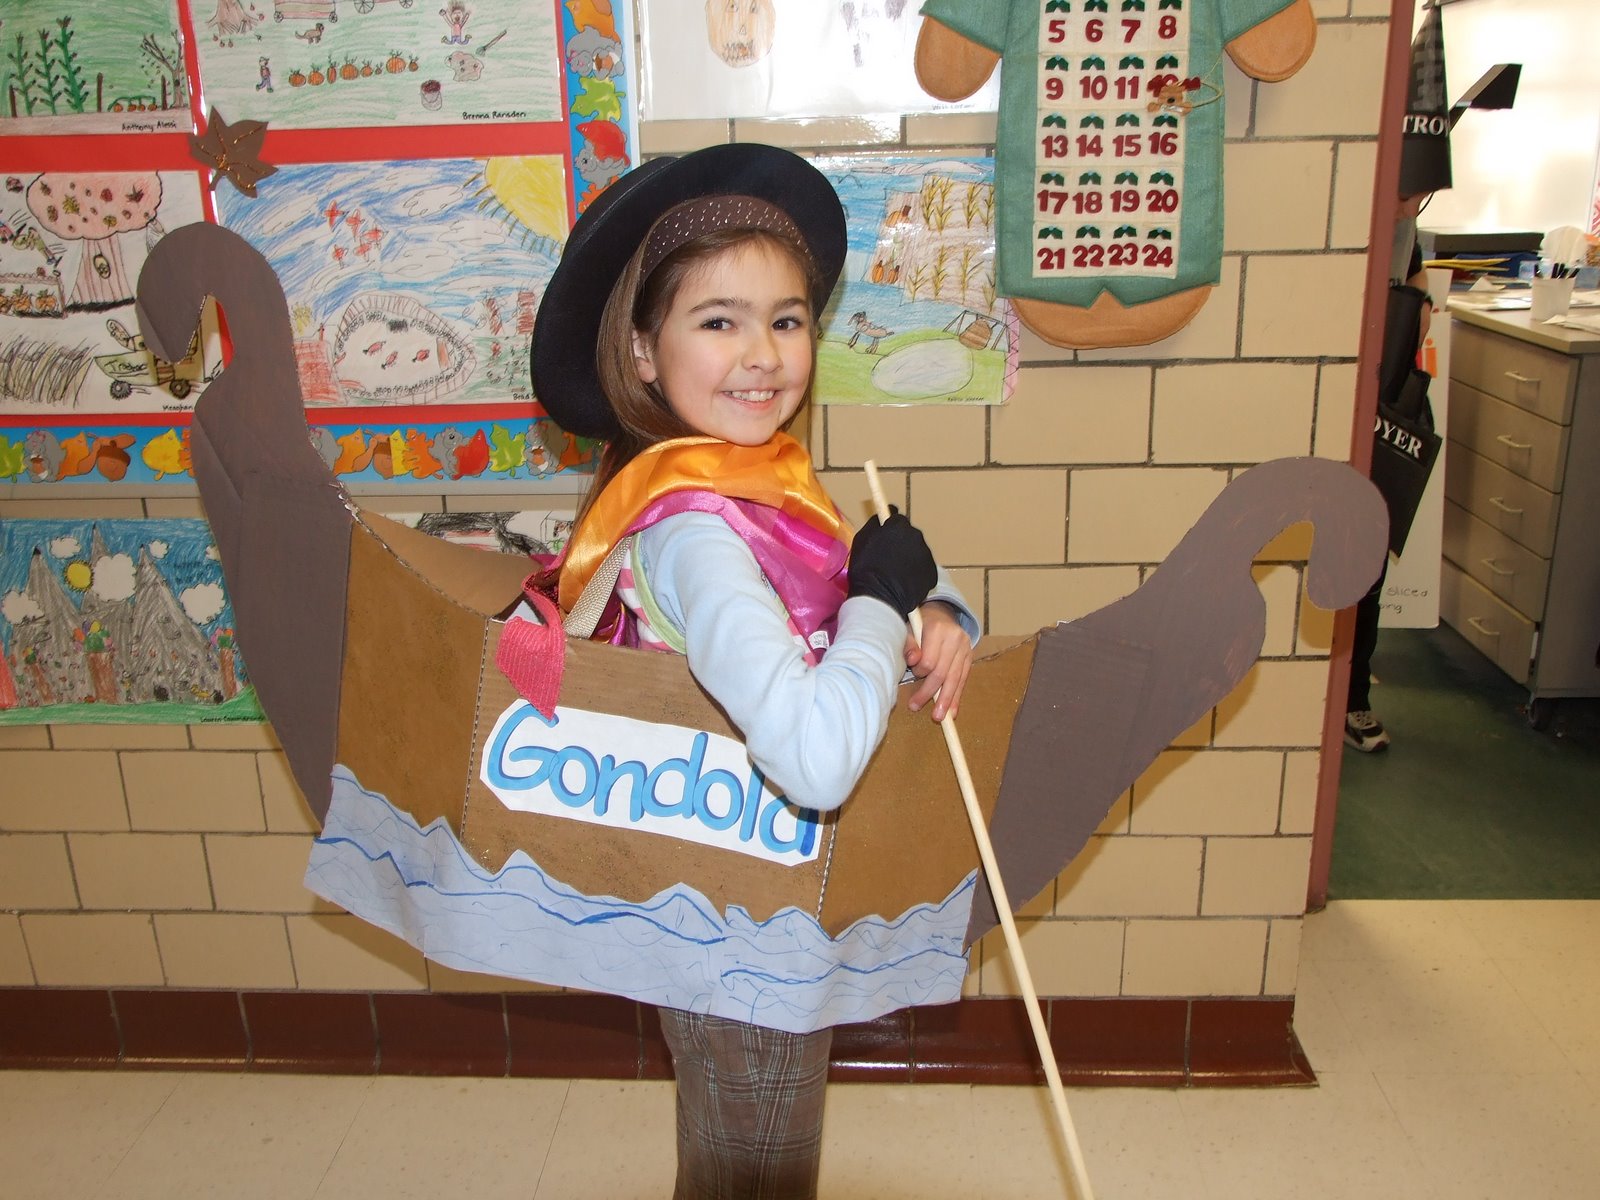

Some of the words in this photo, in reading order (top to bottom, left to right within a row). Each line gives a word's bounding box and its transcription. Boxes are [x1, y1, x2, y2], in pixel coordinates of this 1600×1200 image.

[1048, 19, 1066, 43] 5
[1085, 19, 1104, 43] 6
[1121, 19, 1141, 43] 7
[1158, 15, 1177, 39] 8
[1045, 77, 1064, 100] 9
[1079, 75, 1108, 100] 10
[1114, 76, 1140, 99] 11
[1041, 134, 1069, 158] 13
[1076, 134, 1103, 157] 14
[1112, 134, 1142, 157] 15
[1148, 132, 1178, 156] 16
[1037, 189, 1069, 214] 17
[1072, 191, 1103, 214] 18
[1110, 189, 1141, 212] 19
[1145, 189, 1179, 213] 20
[1037, 247, 1066, 270] 21
[1072, 244, 1105, 268] 22
[1107, 242, 1139, 266] 23
[1142, 244, 1173, 268] 24
[487, 702, 817, 856] Gondola
